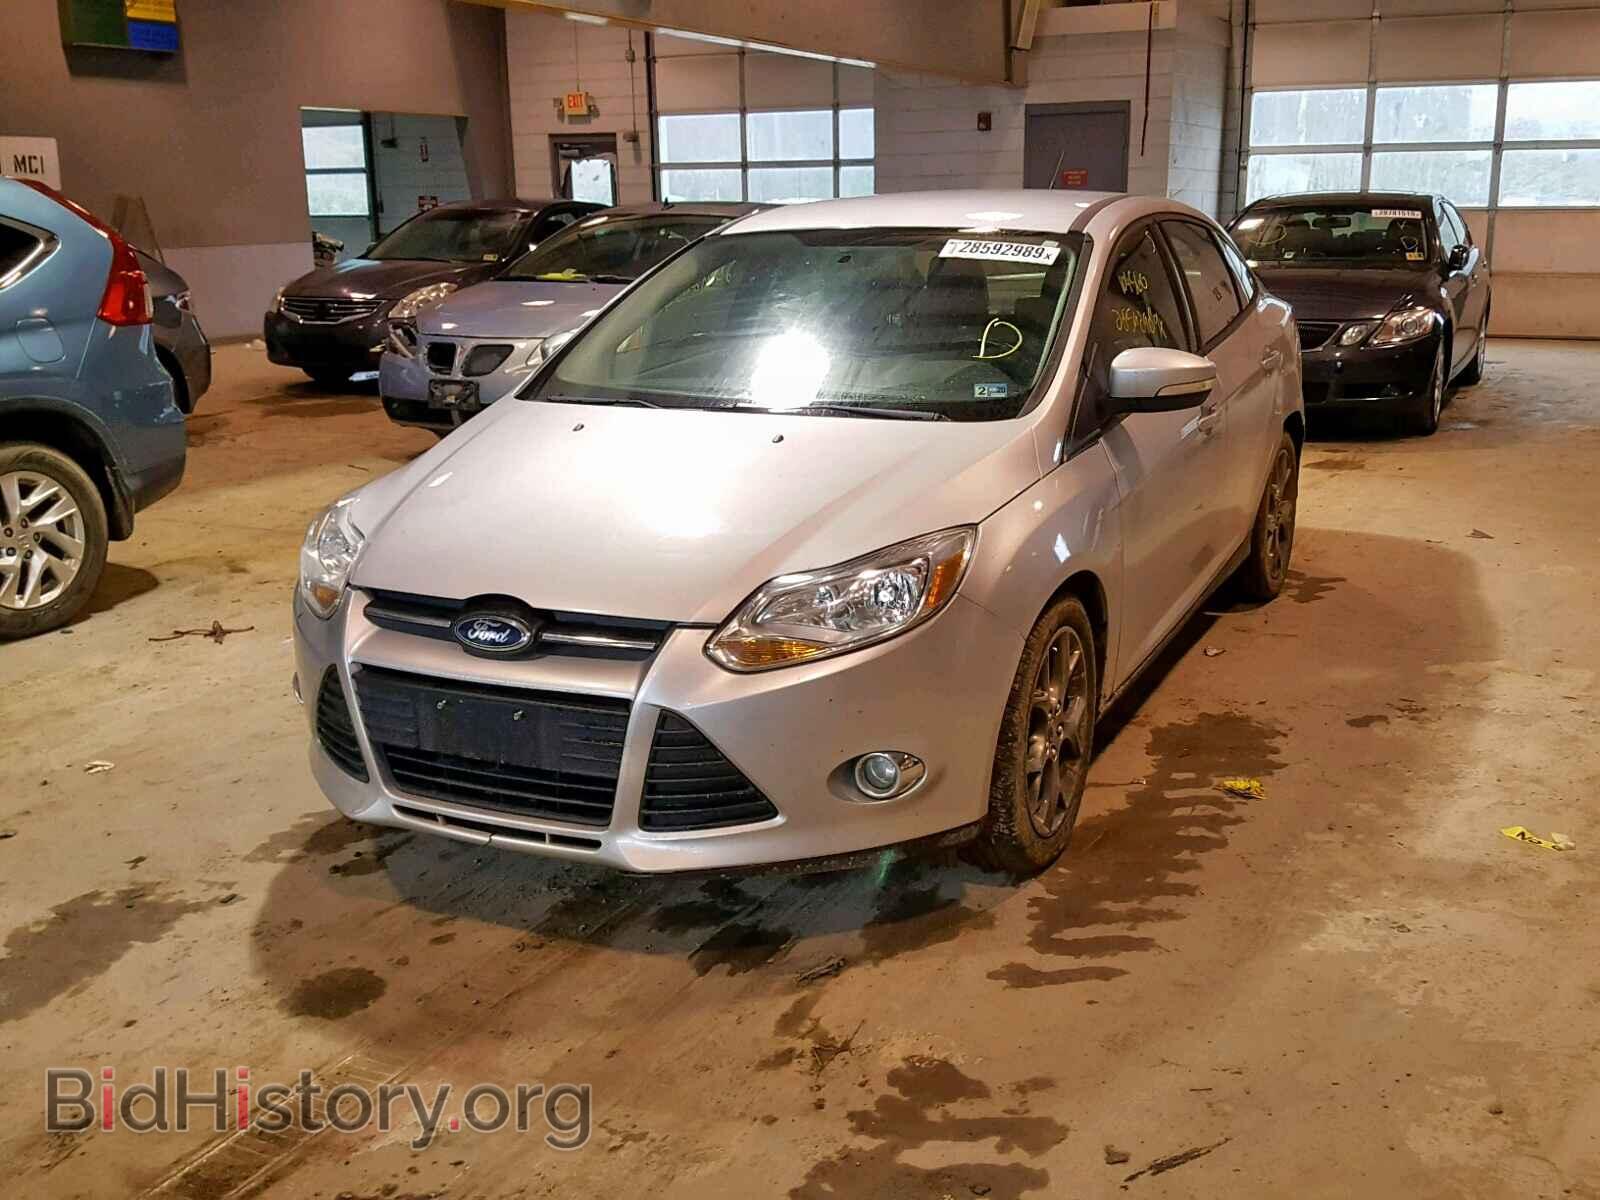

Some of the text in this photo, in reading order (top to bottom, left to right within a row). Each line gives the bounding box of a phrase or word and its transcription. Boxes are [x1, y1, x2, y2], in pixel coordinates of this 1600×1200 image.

[568, 94, 584, 108] EXIT
[971, 317, 1023, 358] D
[977, 386, 986, 396] 2
[468, 620, 511, 643] Ford
